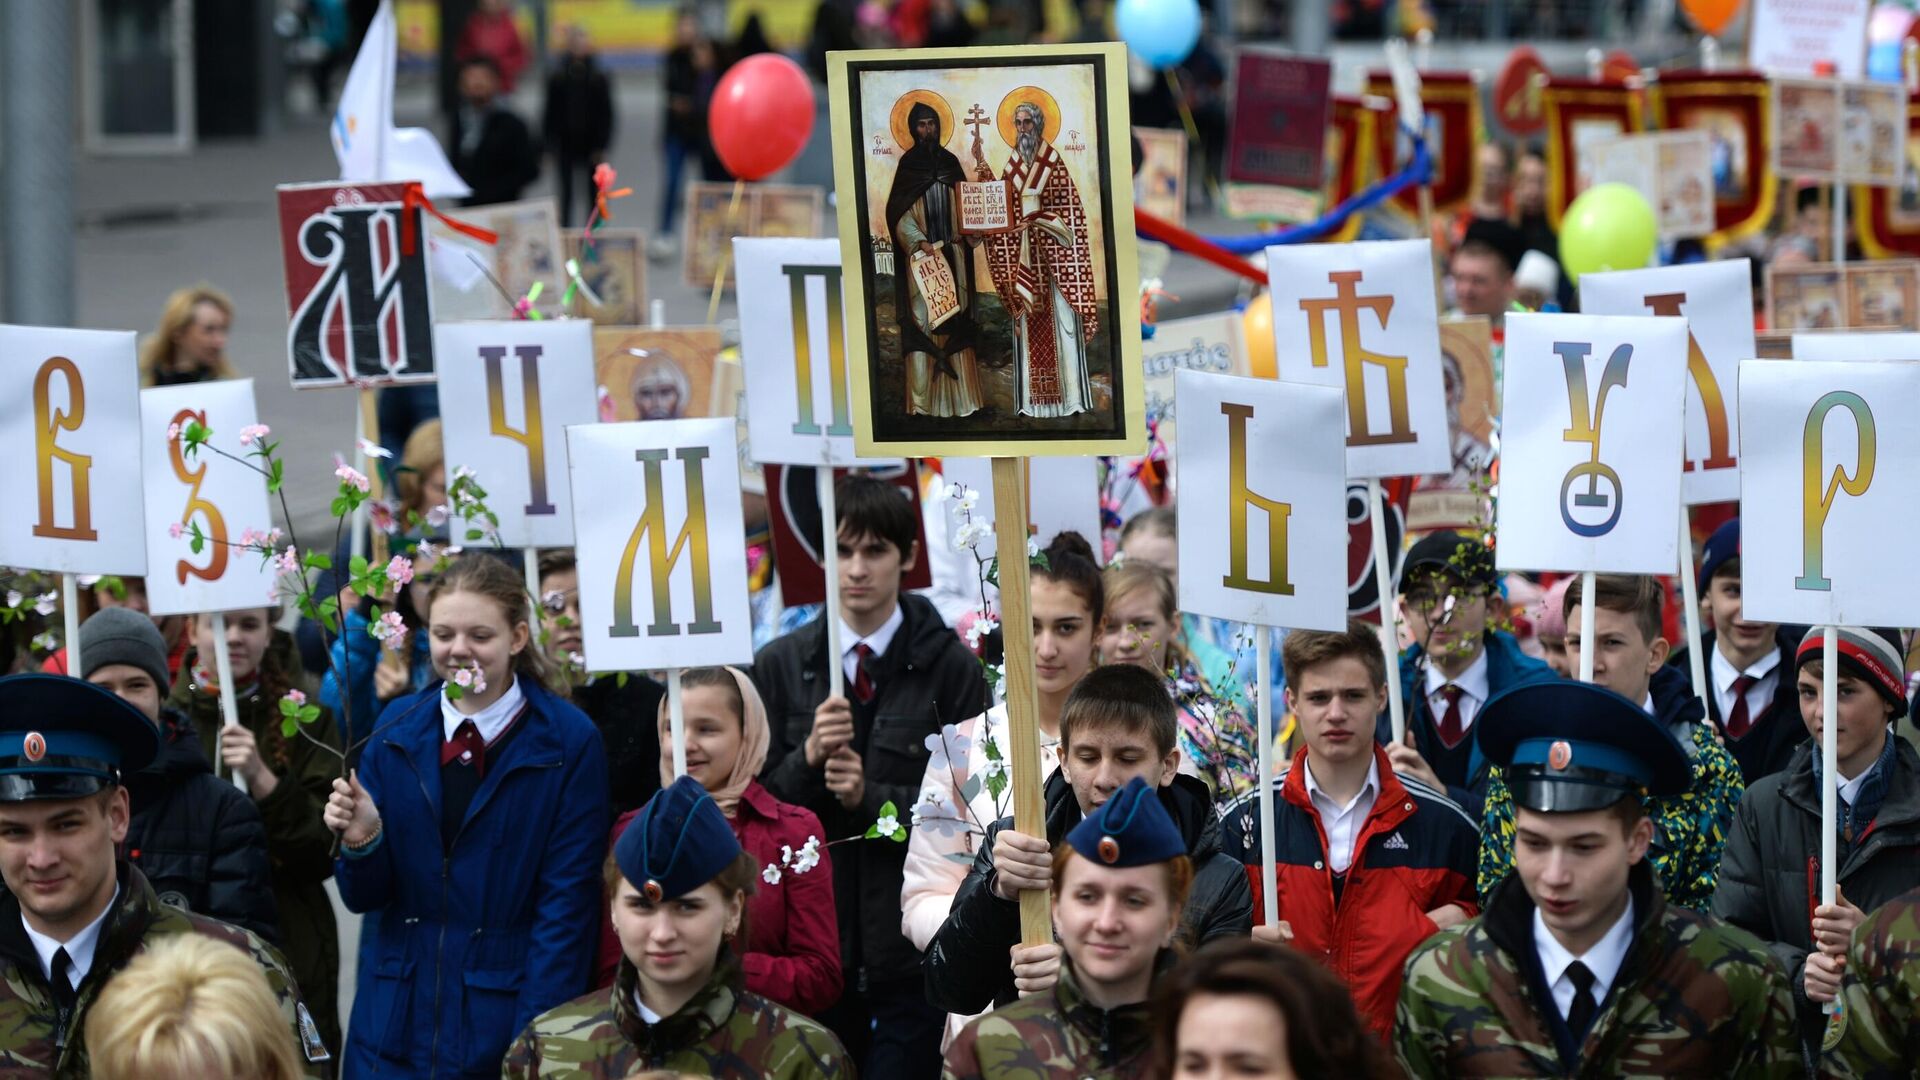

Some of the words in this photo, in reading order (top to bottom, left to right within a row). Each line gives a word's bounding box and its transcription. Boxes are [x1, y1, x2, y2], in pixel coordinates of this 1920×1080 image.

[478, 345, 556, 515] Ч
[782, 264, 852, 436] П
[1794, 390, 1876, 591] Р
